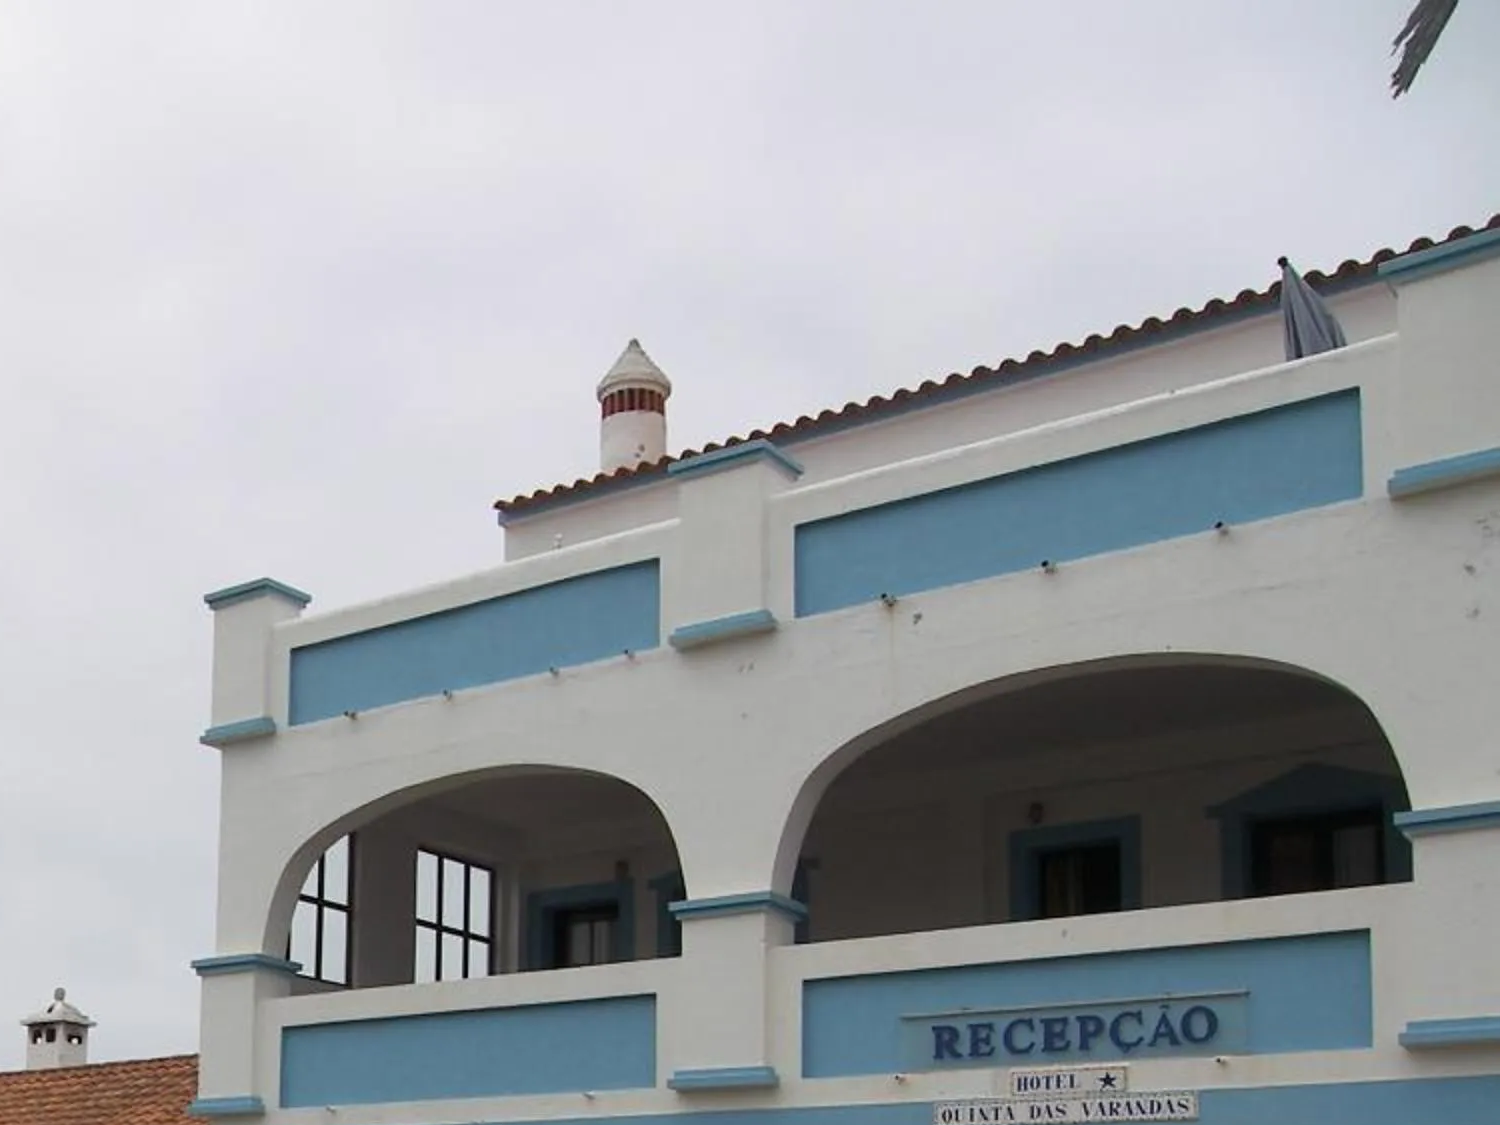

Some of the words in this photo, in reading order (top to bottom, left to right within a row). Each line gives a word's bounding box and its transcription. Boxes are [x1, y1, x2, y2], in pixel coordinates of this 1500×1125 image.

[931, 1005, 1218, 1060] RECEPÇÃO
[1016, 1074, 1081, 1093] HOTEL
[941, 1106, 1016, 1124] QUINTA
[1029, 1104, 1068, 1119] DAS
[1082, 1099, 1191, 1118] VARANDAS
